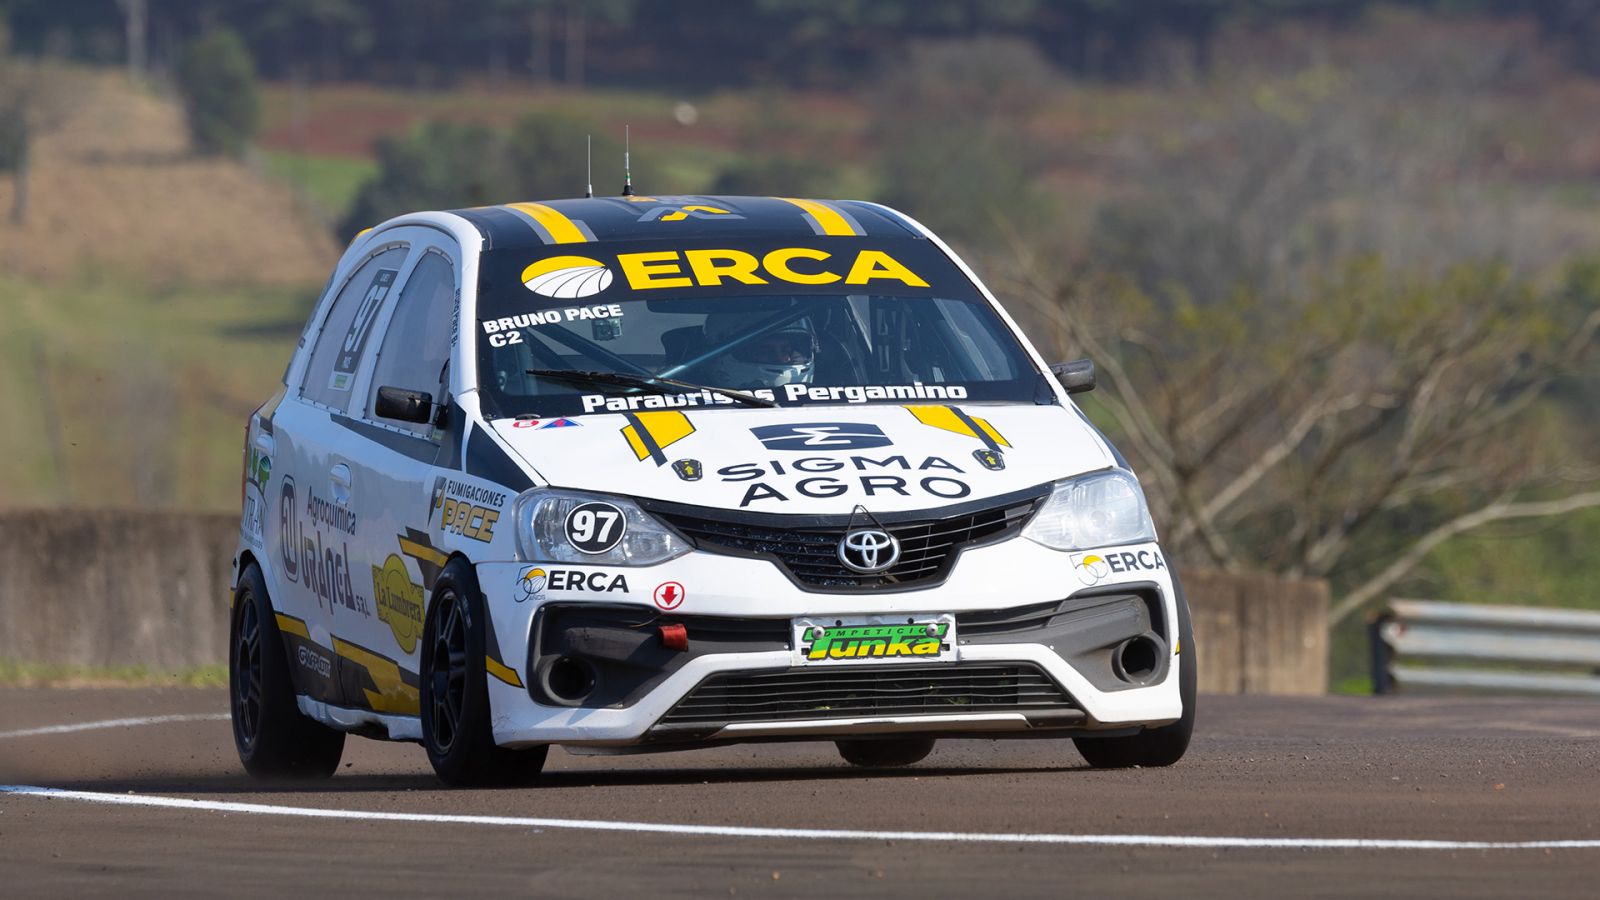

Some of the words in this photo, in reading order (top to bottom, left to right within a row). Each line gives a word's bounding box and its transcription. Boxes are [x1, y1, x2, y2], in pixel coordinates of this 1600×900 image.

[617, 248, 931, 290] ERCA
[483, 310, 562, 334] BRUNO
[564, 304, 624, 321] PACE
[489, 331, 523, 348] C2
[785, 381, 968, 403] Pergamino
[717, 456, 967, 481] SIGMA
[447, 480, 506, 507] FUMIGACIONES
[739, 476, 971, 507] AGRO
[306, 485, 356, 536] Agroquímica
[441, 497, 501, 544] PACE
[572, 510, 619, 543] 97
[1105, 550, 1167, 573] ERCA
[548, 570, 629, 593] ERCA
